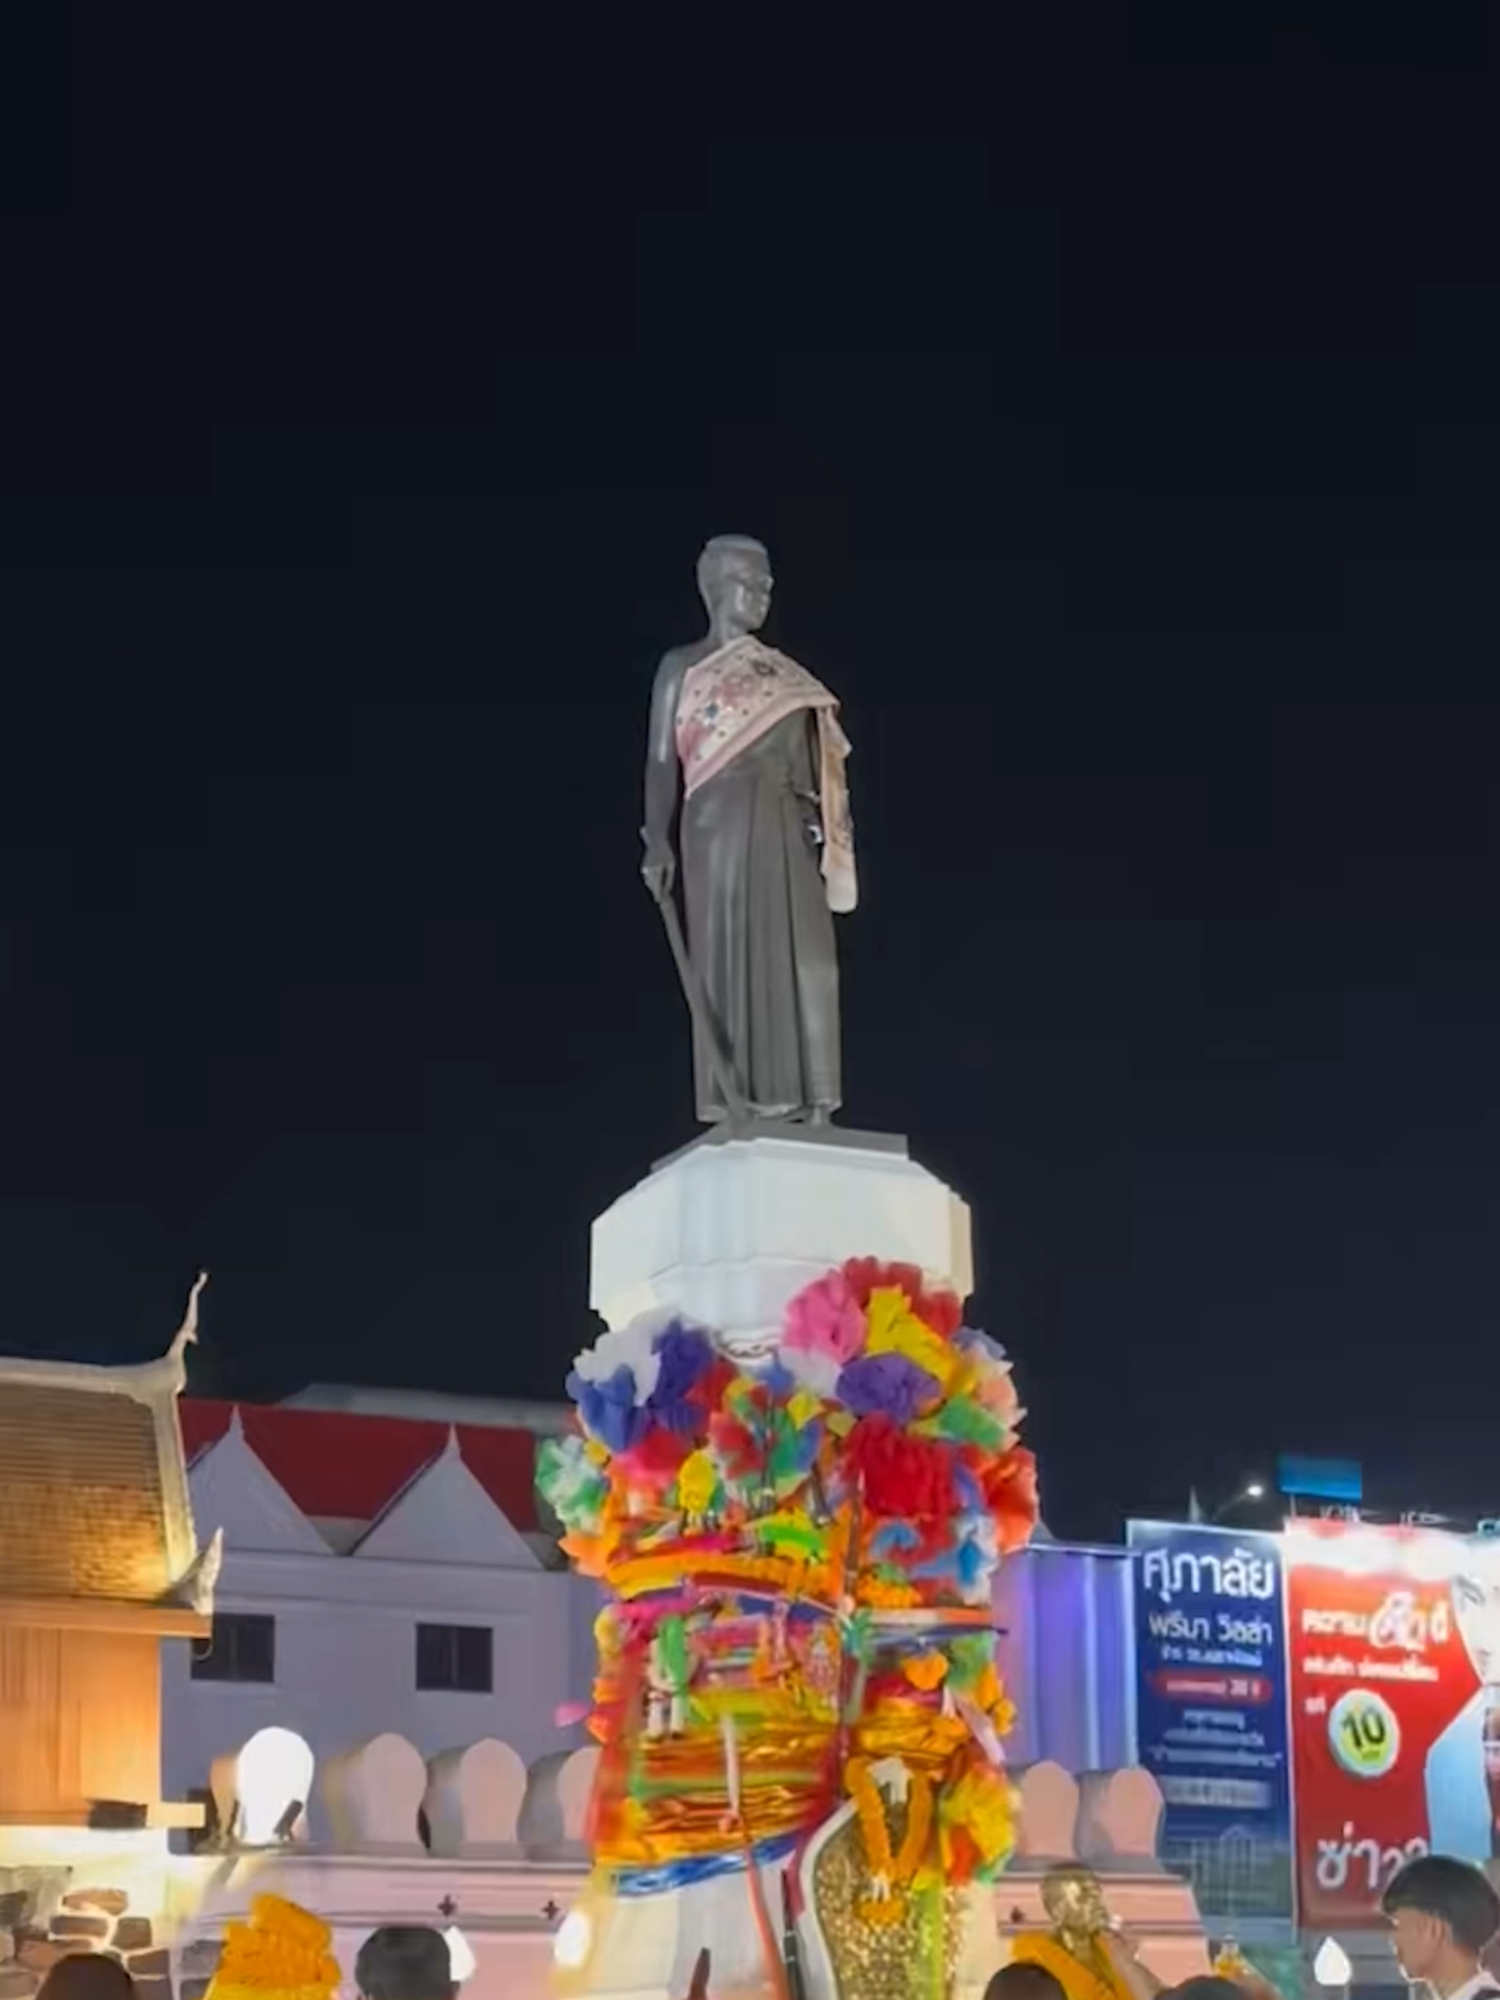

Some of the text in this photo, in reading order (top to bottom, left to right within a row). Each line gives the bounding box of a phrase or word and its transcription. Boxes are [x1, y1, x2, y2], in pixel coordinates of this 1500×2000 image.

[1143, 1547, 1273, 1603] ศุภาลัย
[1341, 1708, 1387, 1750] 10
